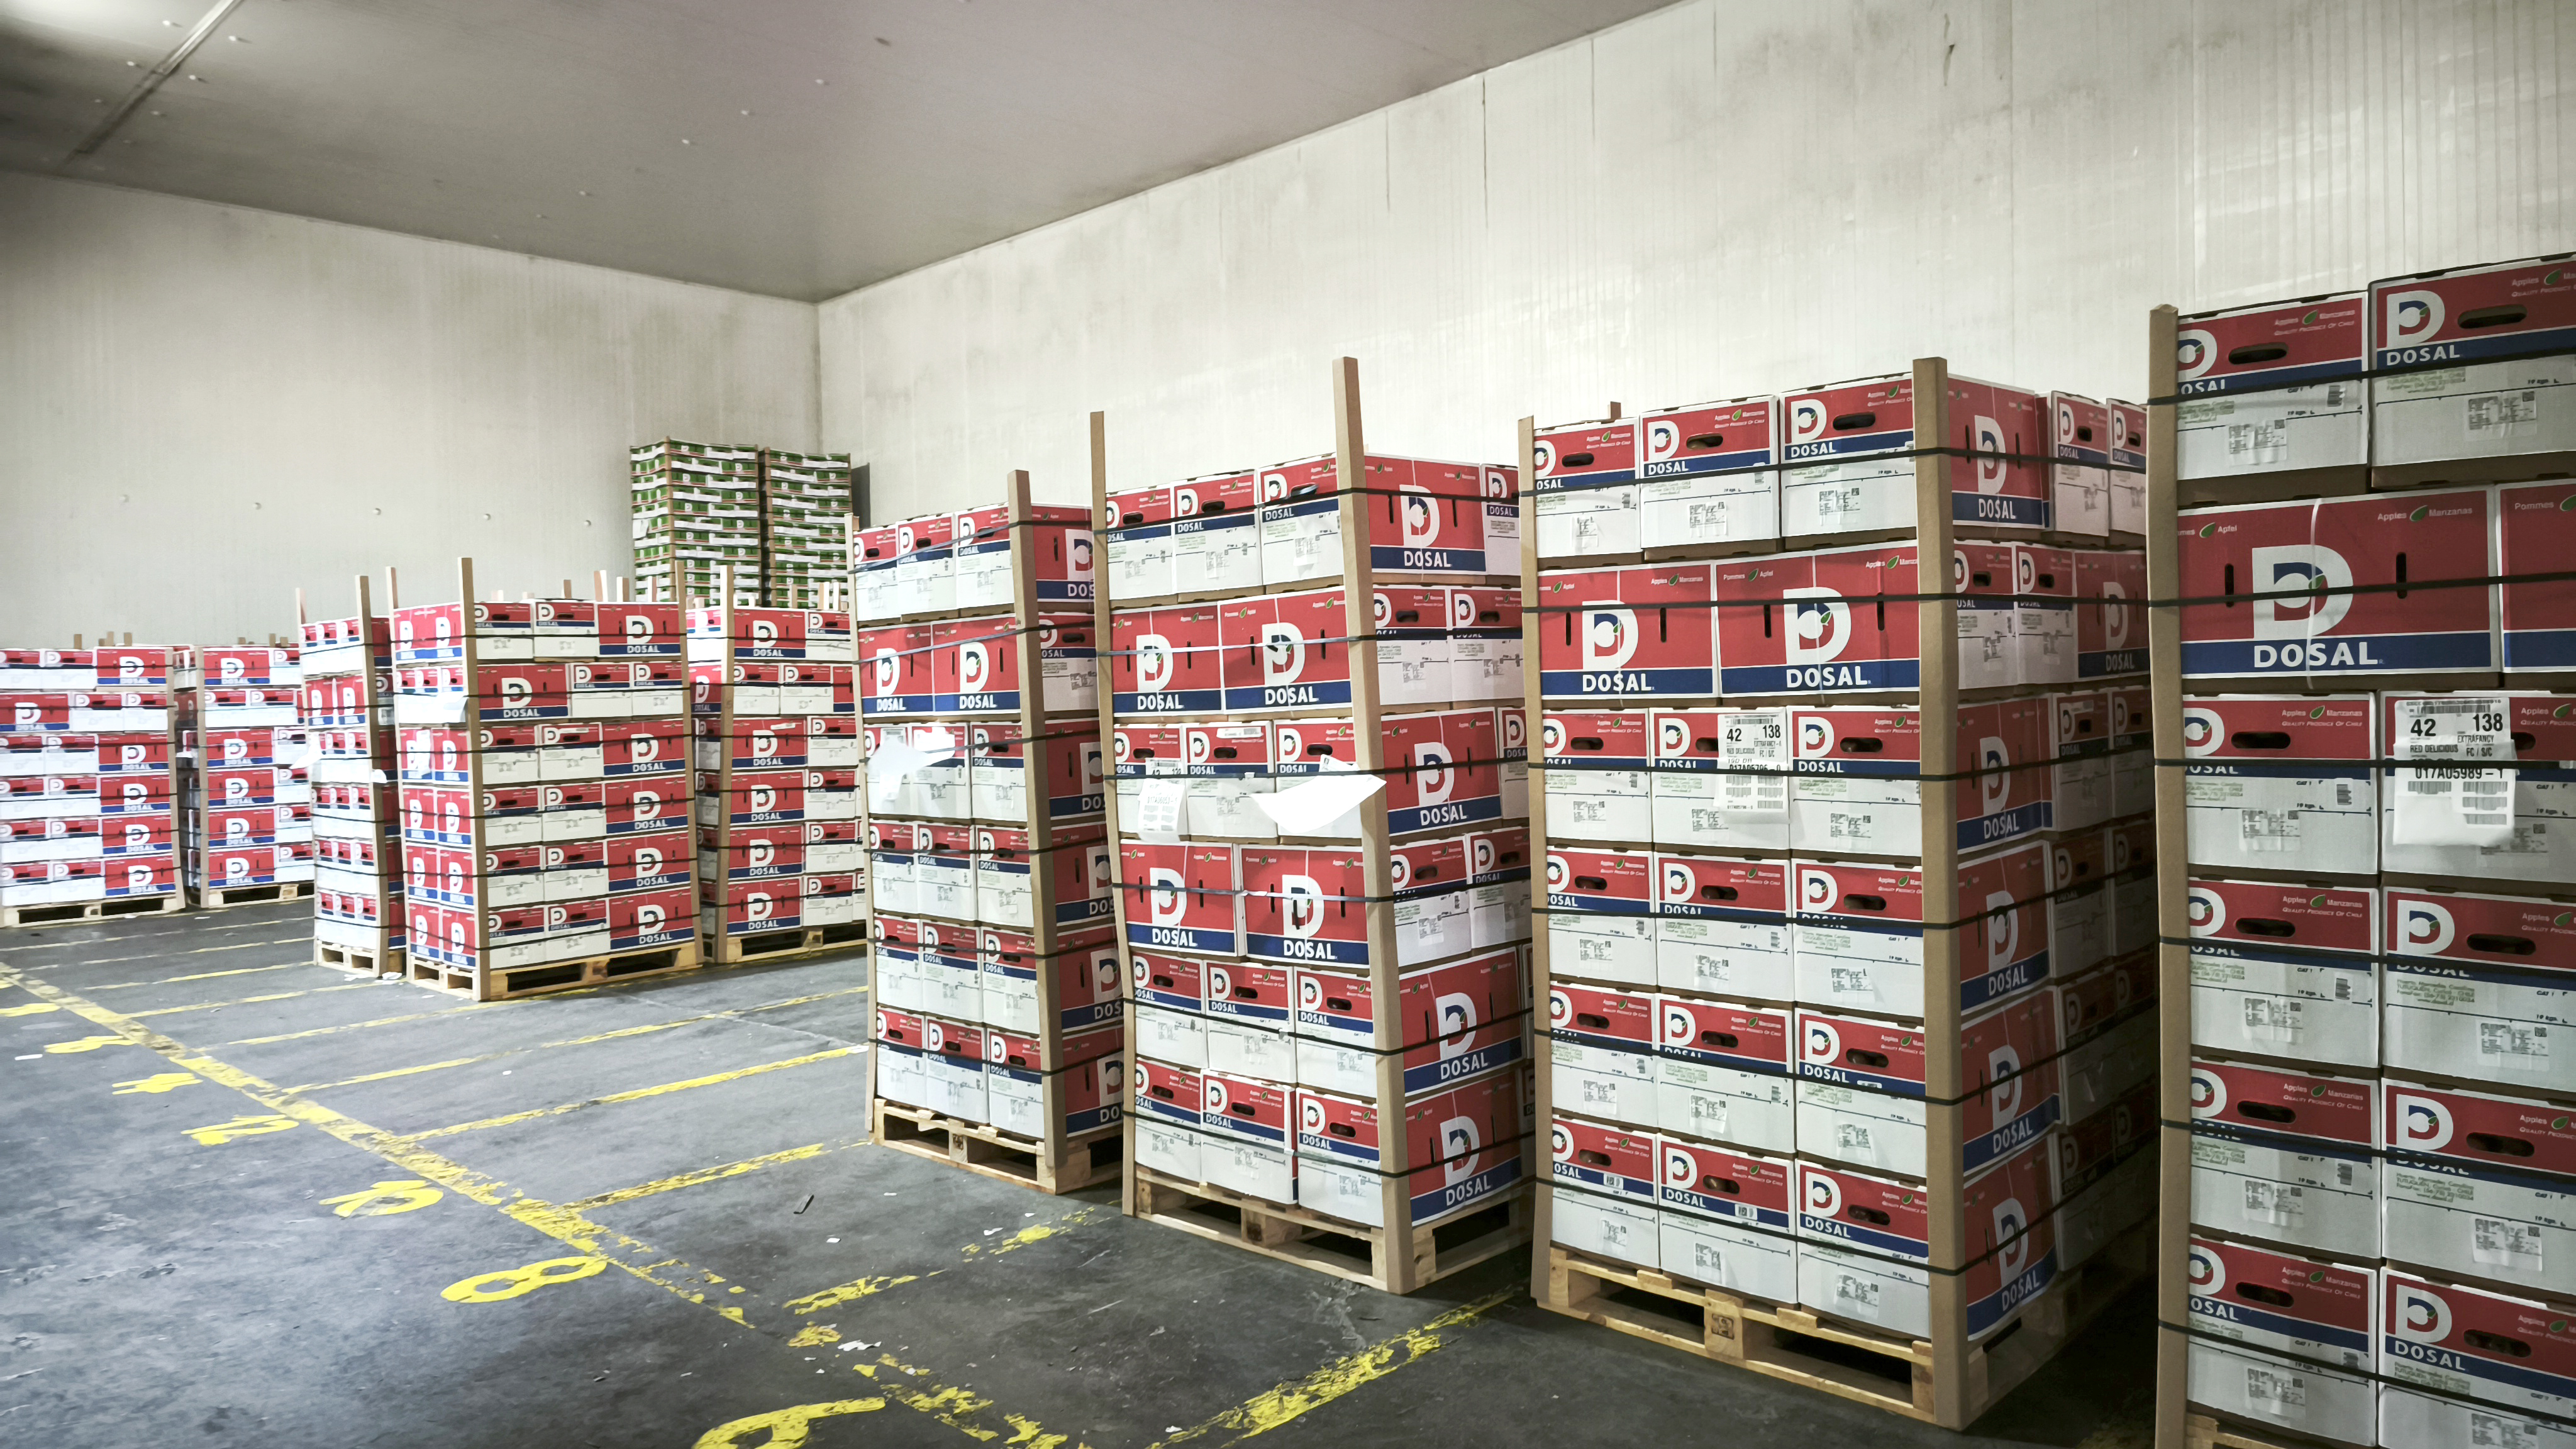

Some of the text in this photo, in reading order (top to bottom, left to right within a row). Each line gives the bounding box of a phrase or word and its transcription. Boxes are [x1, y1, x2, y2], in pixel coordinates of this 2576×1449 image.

[2387, 345, 2460, 365] DOSAL
[1791, 442, 1836, 457] DOSAL
[1648, 461, 1689, 475] DOSAL
[1536, 479, 1563, 489] OSAL
[1490, 506, 1513, 516] DOSAL
[1979, 499, 2016, 519] DOSAL
[2515, 502, 2554, 510] Pommes
[1266, 508, 1294, 519] DOSAL
[2378, 507, 2472, 521] Apples Manzanas
[1178, 522, 1203, 532] DOSAL
[1108, 533, 1124, 542] OSAL
[1404, 551, 1451, 567] DOSAL
[1068, 584, 1094, 597] DOS
[628, 645, 660, 653] DOSAL
[2255, 642, 2379, 667] DOSAL
[2106, 653, 2135, 671] DOSAL
[1583, 674, 1652, 692] DOSAL
[1787, 666, 1867, 687] DOSAL
[960, 695, 997, 709] DOSAL
[1138, 694, 1184, 710] DOSAL
[1265, 687, 1317, 705] DOSAL
[877, 698, 906, 711] DOSAL
[504, 708, 541, 718] DOSAL
[2521, 708, 2549, 718] Apples
[2410, 718, 2436, 736] 42
[2472, 713, 2503, 731] 138
[1726, 728, 1742, 742] 42
[1763, 724, 1781, 738] 138
[2457, 735, 2494, 743] EXTRAFANCY
[1507, 748, 1526, 757] DOSA
[2410, 744, 2458, 753] RED DELICIOUS
[2466, 748, 2475, 757] FC
[633, 762, 665, 771] DOSAL
[1117, 765, 1135, 774] OSAL
[1191, 766, 1216, 774] DOSAL
[1799, 761, 1843, 772] DOSAL
[752, 813, 781, 821] DOSAL
[1420, 805, 1467, 826] DOSAL
[635, 819, 667, 829] DOSAL
[1984, 815, 2019, 839] DOSAL
[750, 867, 780, 875] DOSAL
[636, 877, 669, 886] DOSAL
[1548, 894, 1577, 906] OSAL
[2282, 896, 2363, 908] Apples Manzanas
[2522, 913, 2550, 921] Apples
[748, 920, 779, 930] DOSAL
[639, 933, 672, 943] DOSAL
[1152, 929, 1197, 947] DOSAL
[1284, 940, 1337, 960] DOSAL
[985, 964, 1004, 974] DOSAL
[1989, 970, 2027, 995] DOSAL
[1095, 1004, 1121, 1019] DOS
[1211, 1002, 1237, 1014] DOSAL
[1301, 1012, 1329, 1025] DOSAL
[1441, 1052, 1488, 1079] DOSAL
[1805, 1065, 1849, 1082] DOSAL
[2284, 1083, 2363, 1100] Apples Manzanas
[1136, 1097, 1153, 1110] OSAL
[1206, 1114, 1233, 1128] DOSAL
[2519, 1114, 2547, 1124] Apples
[1303, 1135, 1331, 1150] DOSAL
[1994, 1123, 2033, 1153] DOSAL
[1555, 1164, 1581, 1179] OSAL
[1446, 1175, 1491, 1206] DOSAL
[1667, 1189, 1706, 1208] DOSAL
[1806, 1217, 1850, 1238] DOSAL
[440, 1255, 608, 1303] 8
[2282, 1267, 2306, 1277] Apples
[2002, 1275, 2039, 1311] DOSAL
[2191, 1301, 2238, 1320] OSAL
[2396, 1341, 2465, 1370] DOSAL
